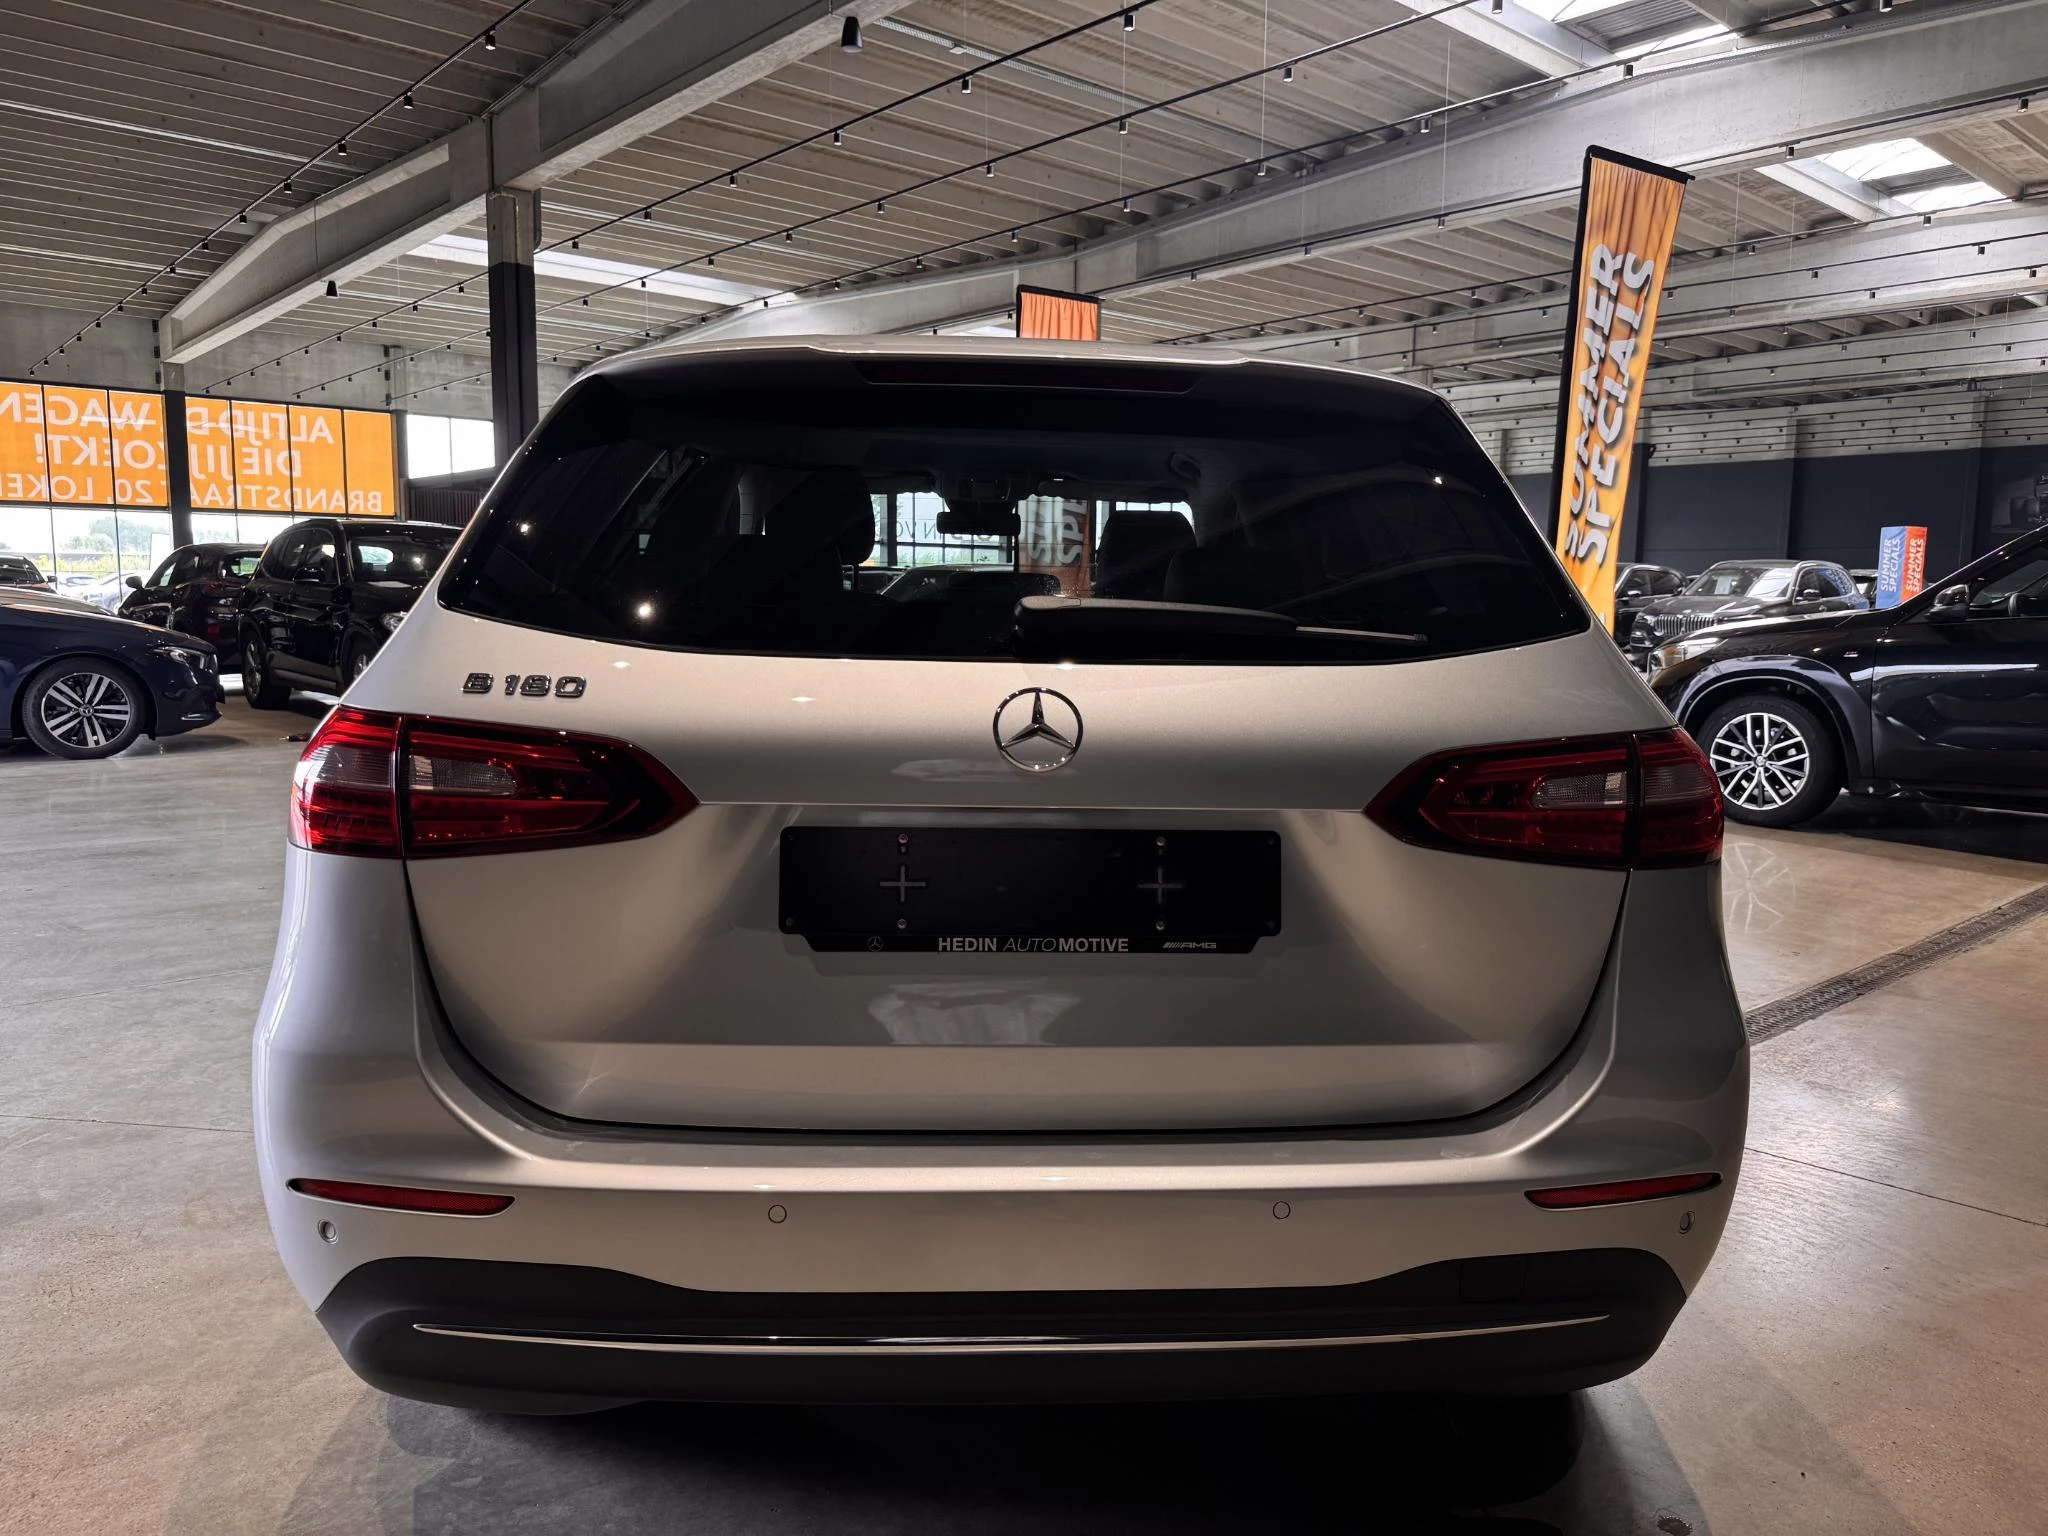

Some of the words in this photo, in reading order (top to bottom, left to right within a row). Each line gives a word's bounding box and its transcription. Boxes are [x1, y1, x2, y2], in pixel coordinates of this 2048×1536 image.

[1577, 251, 1655, 565] SPECIALS
[1881, 538, 1892, 591] SUMMER
[1889, 538, 1900, 592] SPECIALS
[1906, 538, 1917, 591] SUMMER
[1912, 538, 1924, 592] SPECIALS
[462, 672, 494, 694] B
[504, 674, 587, 699] 180
[937, 937, 998, 952] HEDIN
